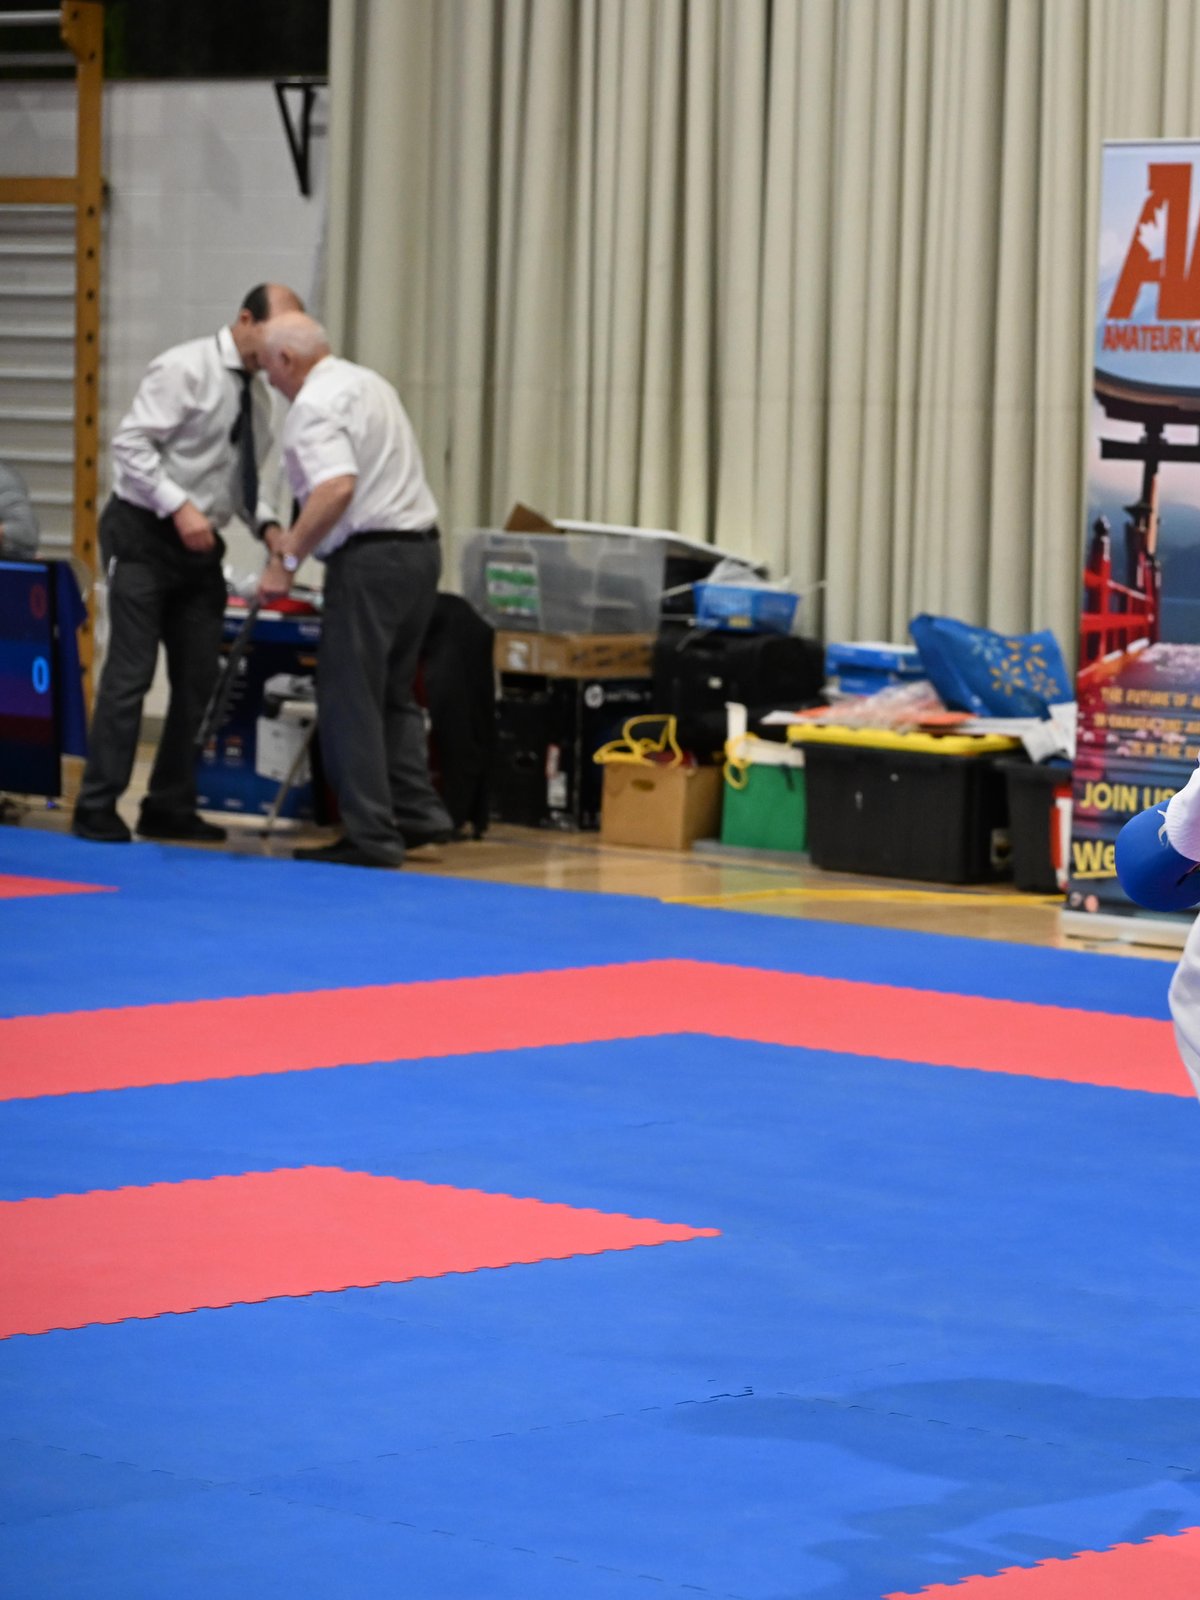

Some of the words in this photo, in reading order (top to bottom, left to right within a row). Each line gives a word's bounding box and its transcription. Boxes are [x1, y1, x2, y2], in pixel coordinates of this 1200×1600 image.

[1103, 325, 1182, 352] AMATEUR
[32, 656, 49, 694] 0
[1080, 782, 1138, 813] JOIN
[1073, 841, 1115, 872] We
